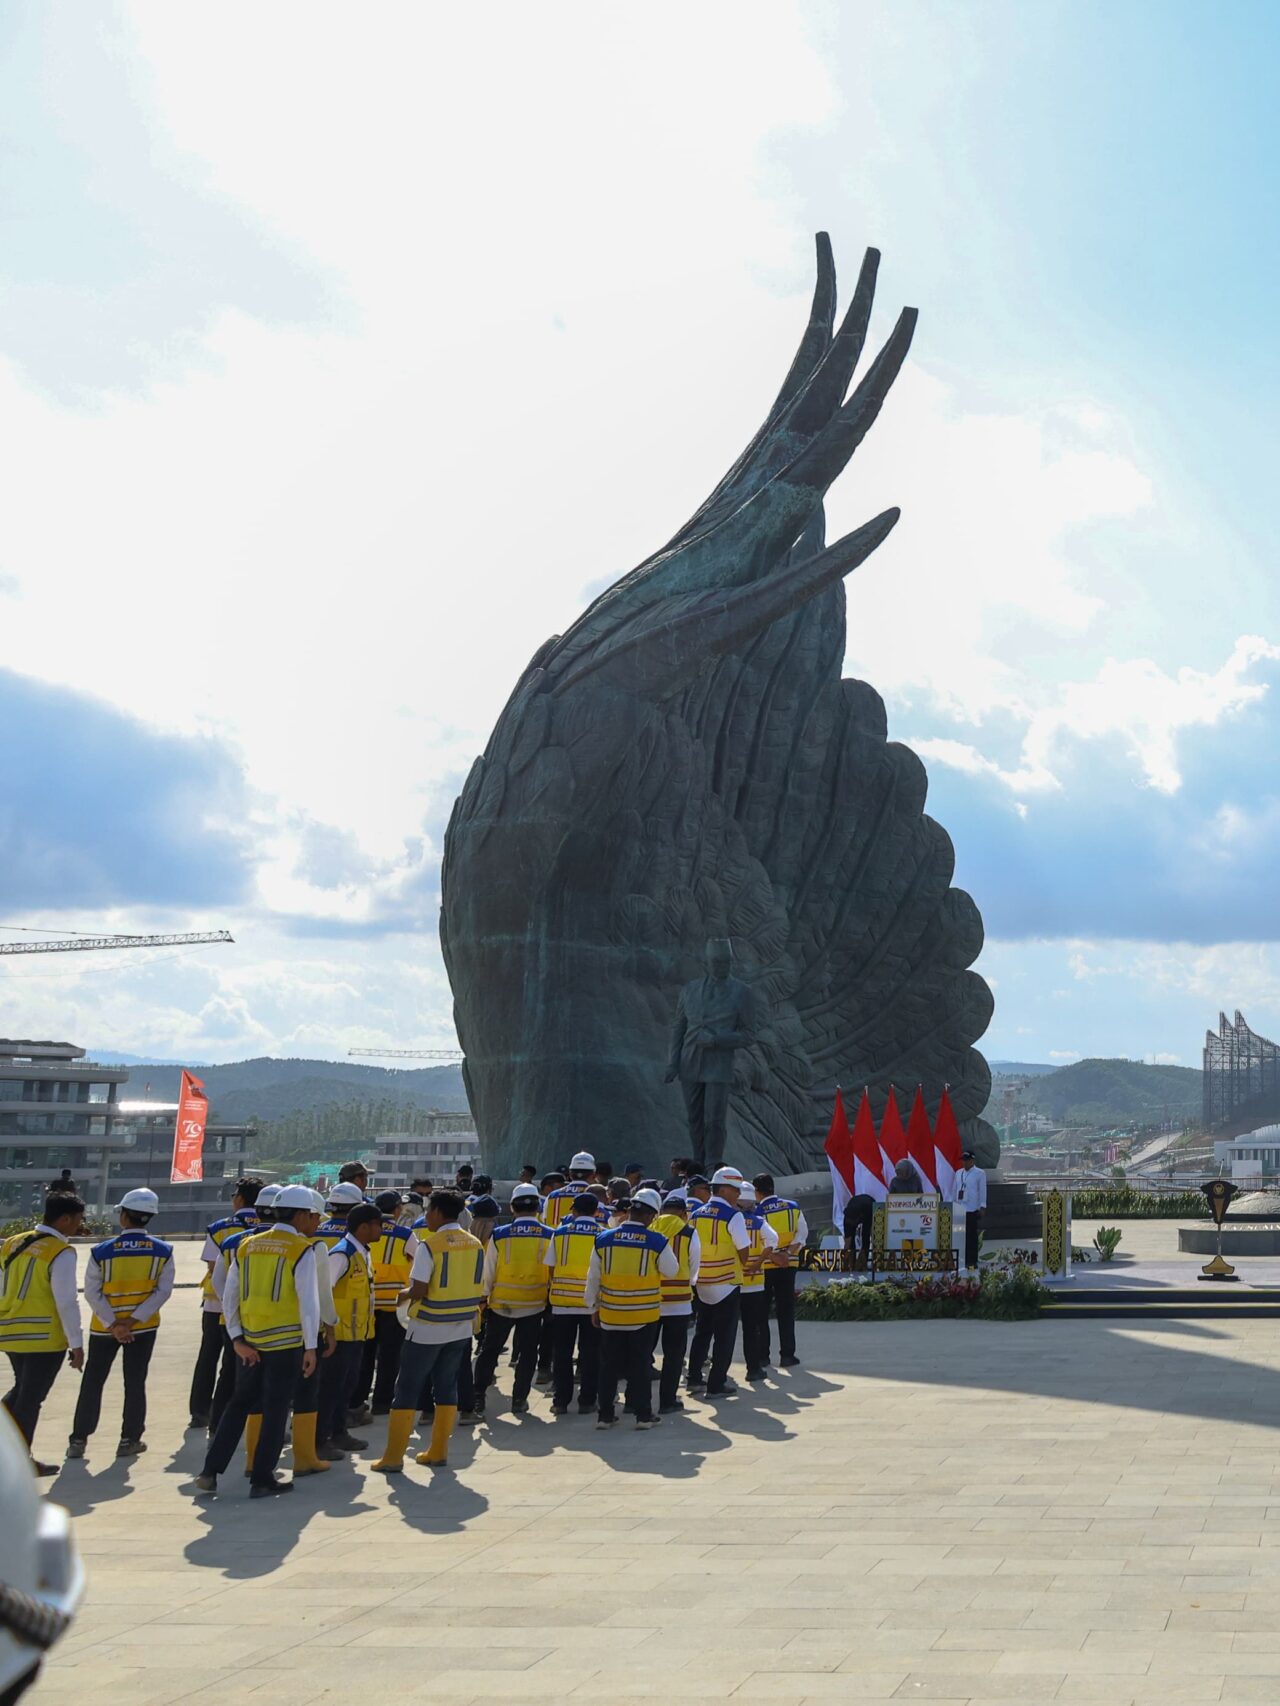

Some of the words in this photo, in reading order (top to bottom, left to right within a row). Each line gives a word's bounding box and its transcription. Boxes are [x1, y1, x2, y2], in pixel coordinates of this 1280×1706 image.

[516, 1225, 543, 1234] PUPR
[621, 1232, 647, 1241] PUPR
[122, 1240, 154, 1248] PUPR
